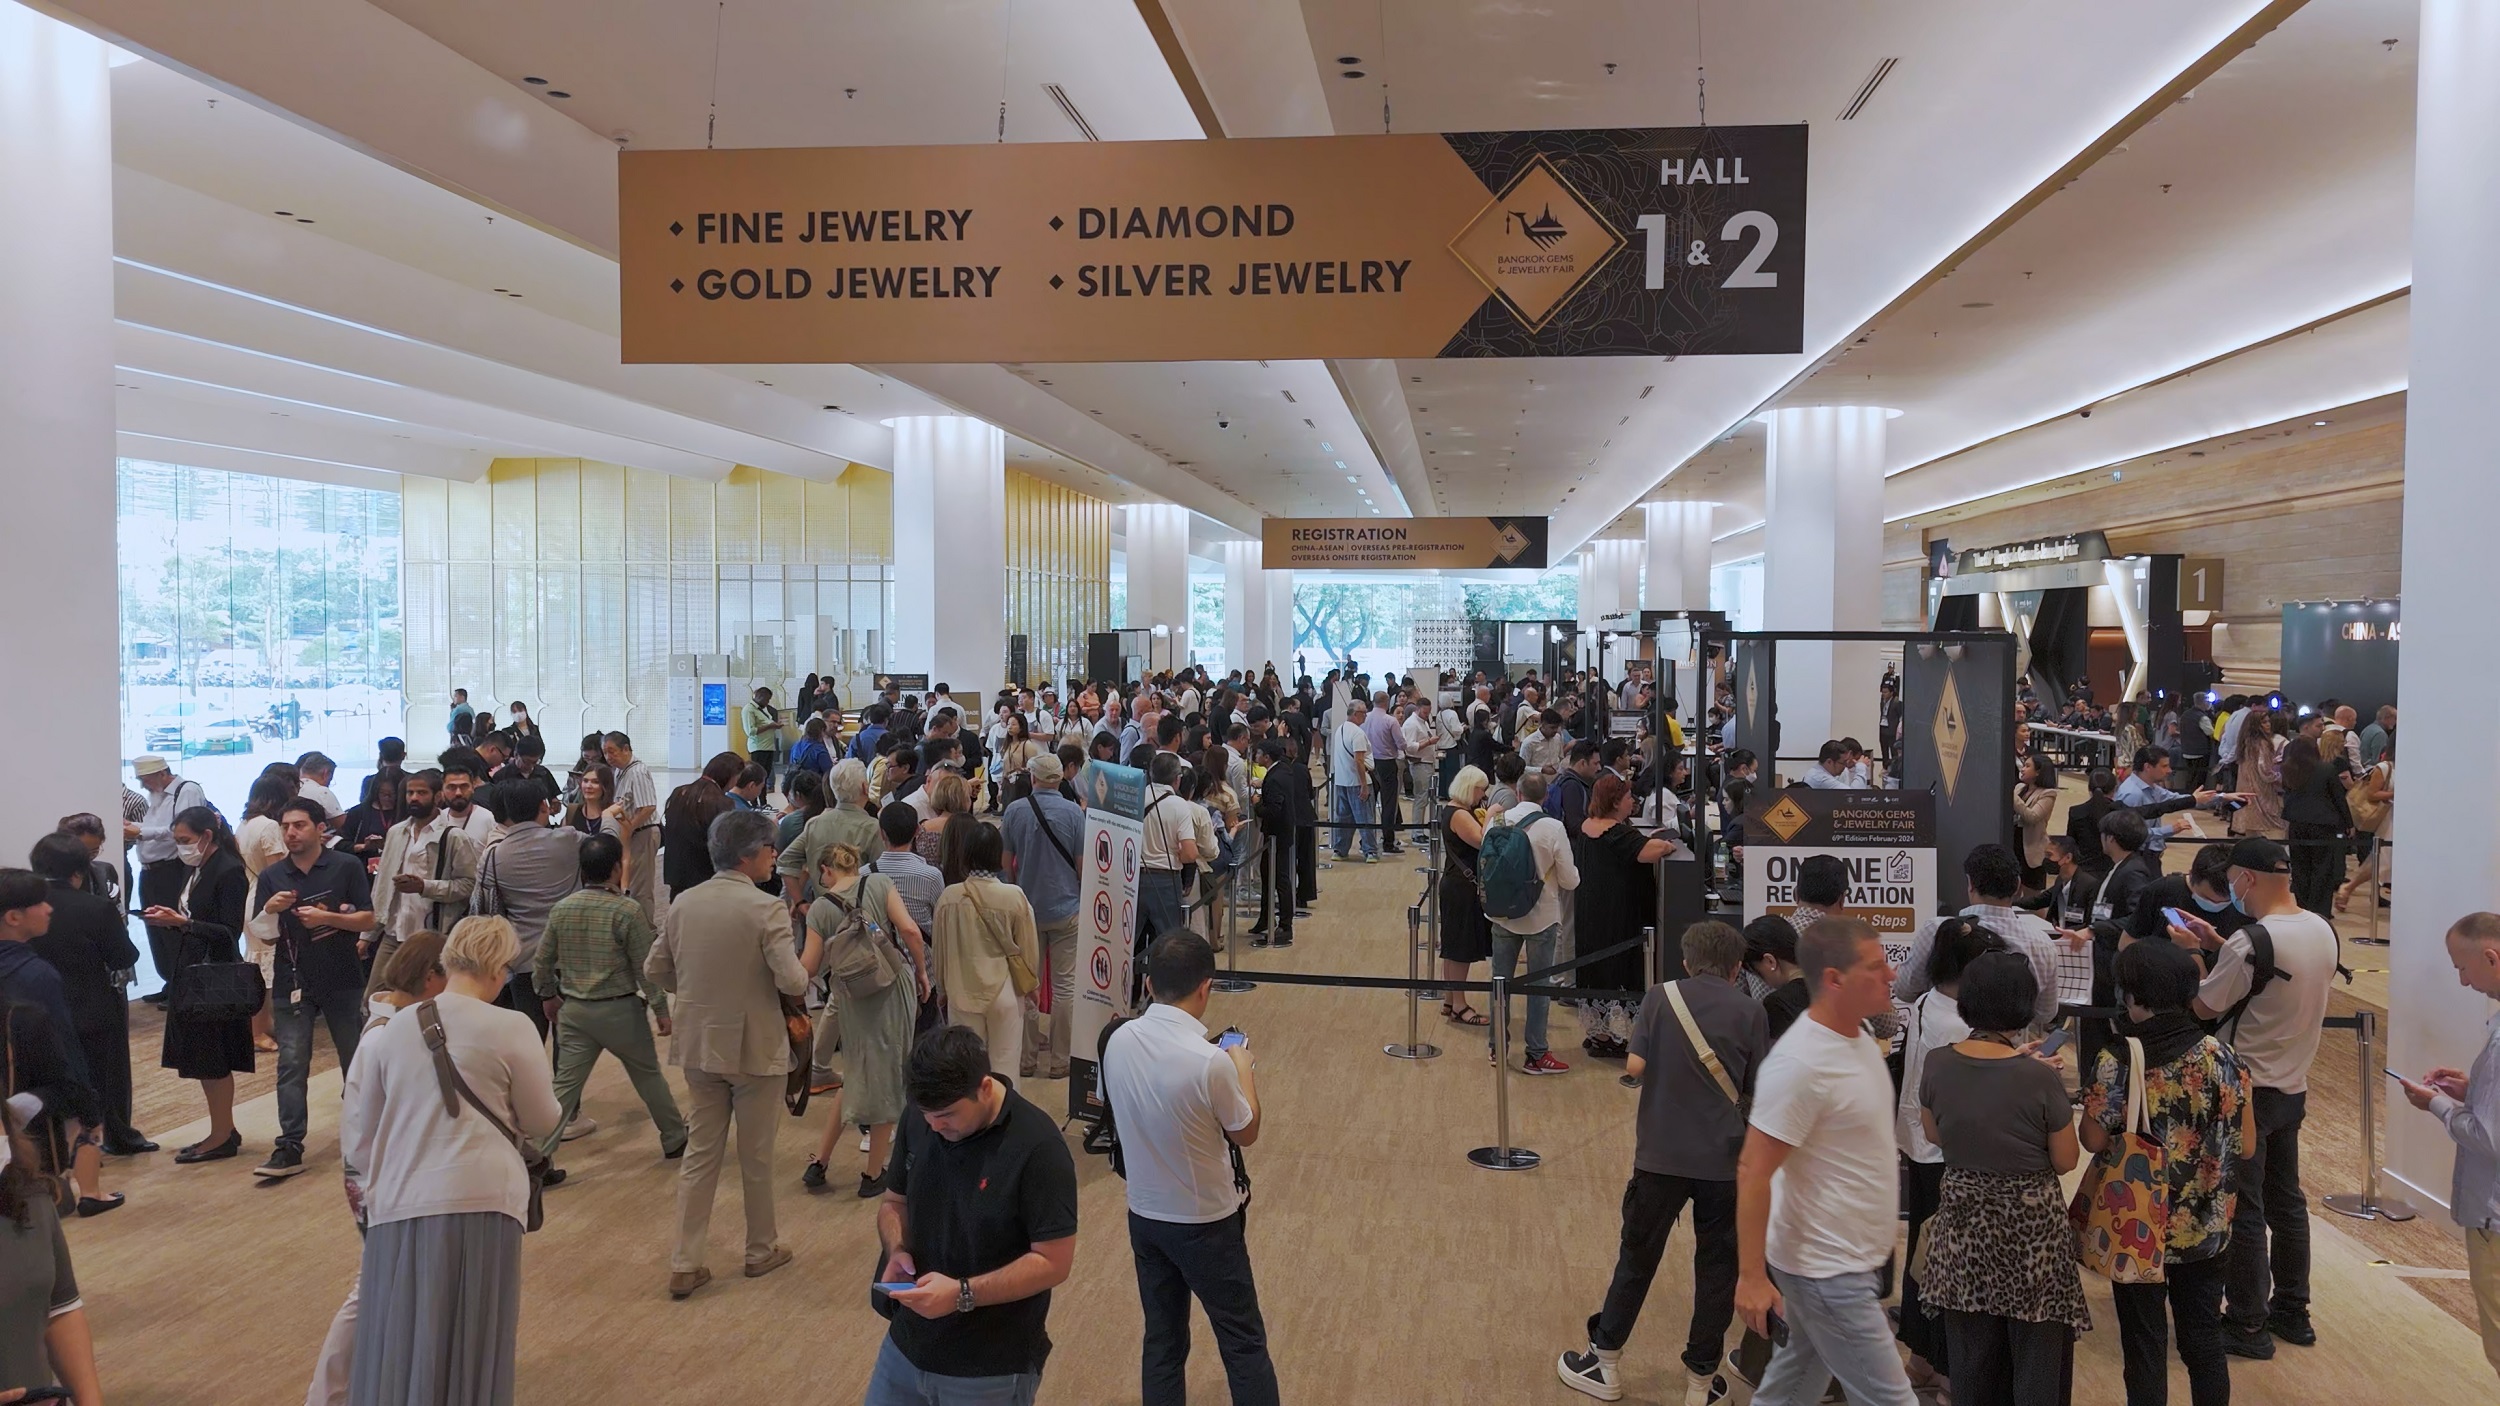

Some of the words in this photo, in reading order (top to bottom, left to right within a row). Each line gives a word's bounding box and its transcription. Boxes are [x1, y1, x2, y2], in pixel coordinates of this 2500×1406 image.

[1660, 157, 1750, 186] HALL
[697, 211, 784, 245] FINE
[798, 209, 974, 243] JEWELRY
[1078, 203, 1295, 240] DIAMOND
[1497, 255, 1545, 264] BANGKOK
[1546, 254, 1574, 263] GEMS
[1635, 213, 1667, 290] 1
[1686, 238, 1713, 266] &
[1720, 210, 1780, 289] 2
[1077, 263, 1213, 298] SILVER
[1228, 259, 1413, 296] JEWELRY
[1507, 265, 1552, 274] JEWELRY
[1552, 265, 1575, 273] FAIR
[697, 267, 813, 301] GOLD
[826, 265, 1002, 299] JEWELRY
[1291, 528, 1407, 541] REGISTRATION
[1392, 543, 1465, 551] PRE-REGISTRATION
[2192, 567, 2206, 602] 1
[2341, 621, 2377, 640] CHINA
[677, 660, 687, 671] G
[1832, 809, 1884, 819] BANGKOK
[1885, 810, 1916, 819] GEMS
[1833, 820, 1842, 829] &
[1842, 820, 1891, 829] JEWELRY
[1892, 820, 1915, 829] FAIR
[1845, 834, 1868, 842] Edition
[1868, 834, 1898, 843] February
[1766, 856, 1882, 884] ONNE
[1766, 885, 1914, 905] RERATION
[1871, 913, 1907, 929] Steps
